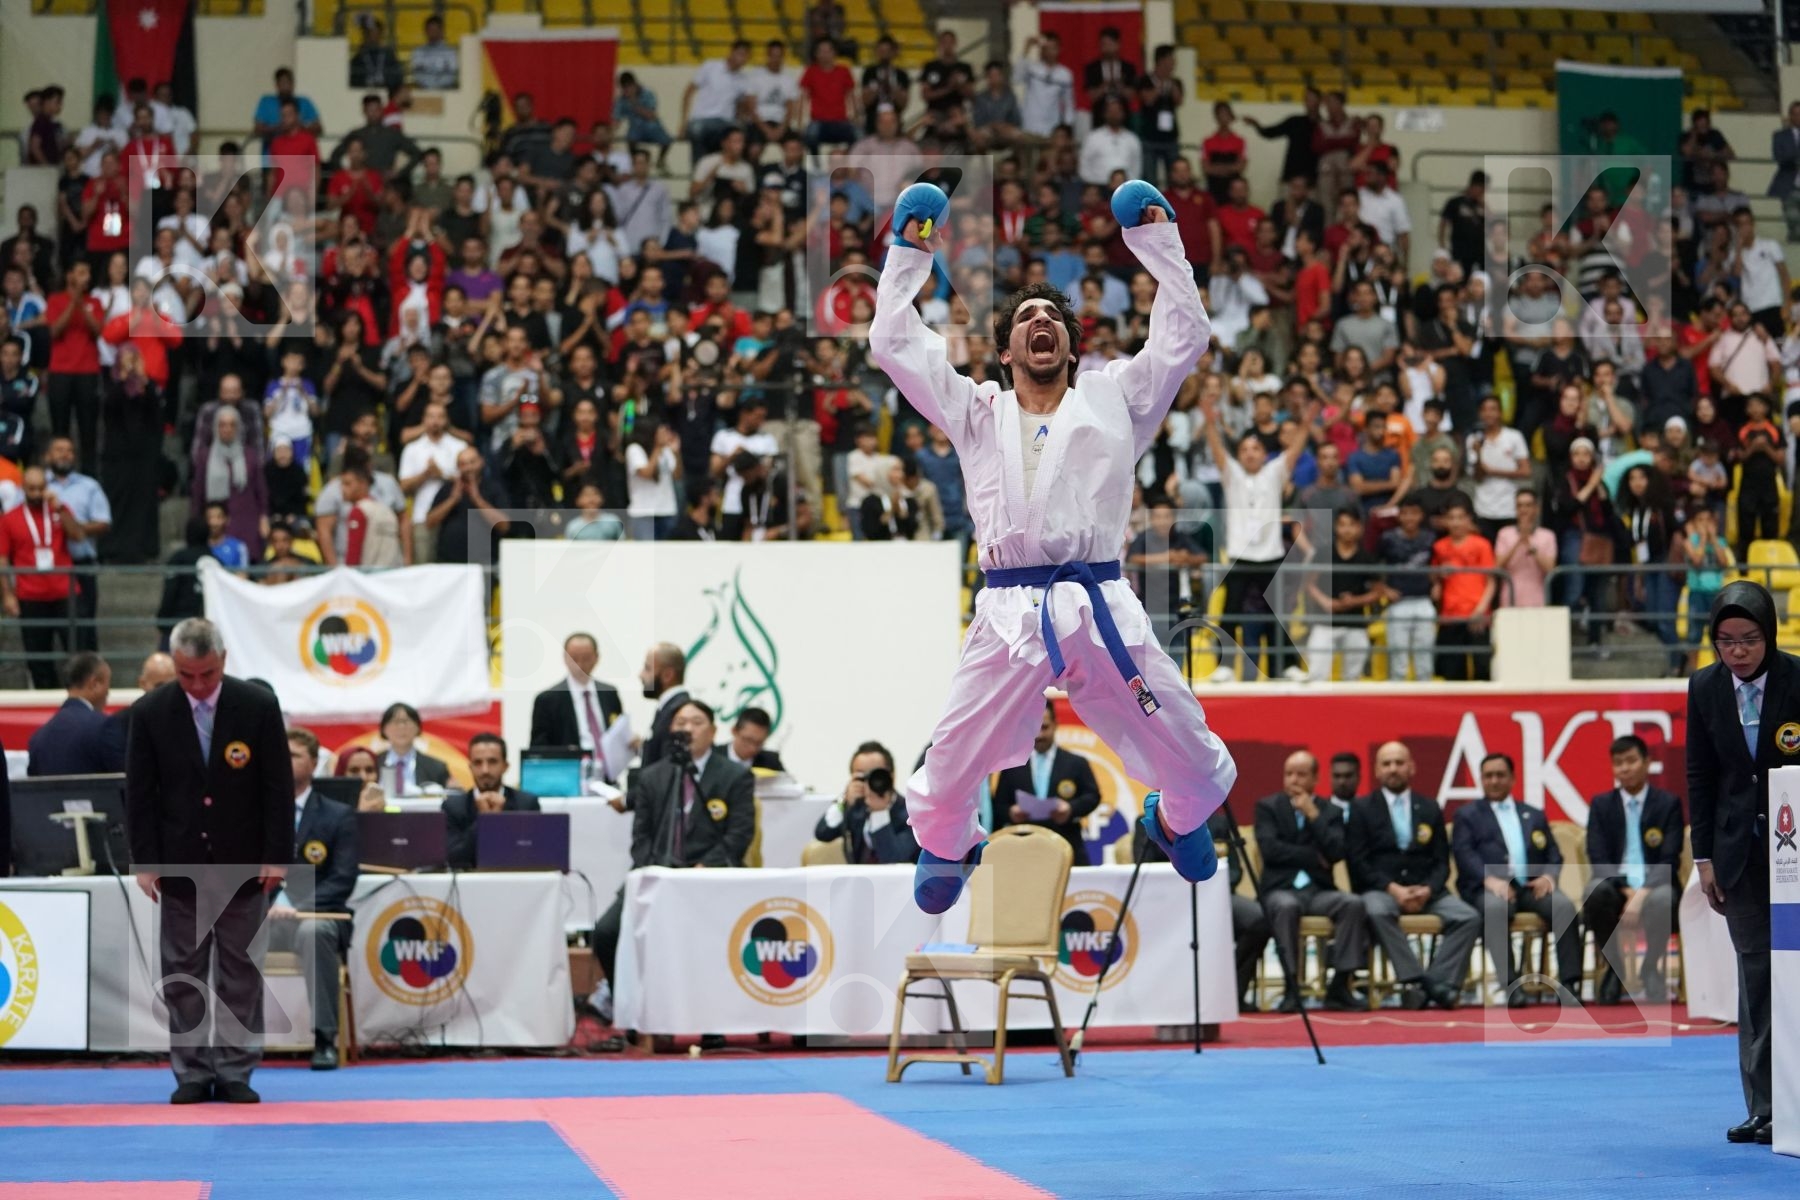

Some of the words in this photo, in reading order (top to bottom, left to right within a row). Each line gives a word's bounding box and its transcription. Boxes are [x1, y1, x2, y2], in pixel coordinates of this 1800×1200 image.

[393, 940, 445, 961] WKF
[755, 940, 807, 961] WKF
[1065, 931, 1115, 952] WKF
[5, 932, 37, 1028] KARATE
